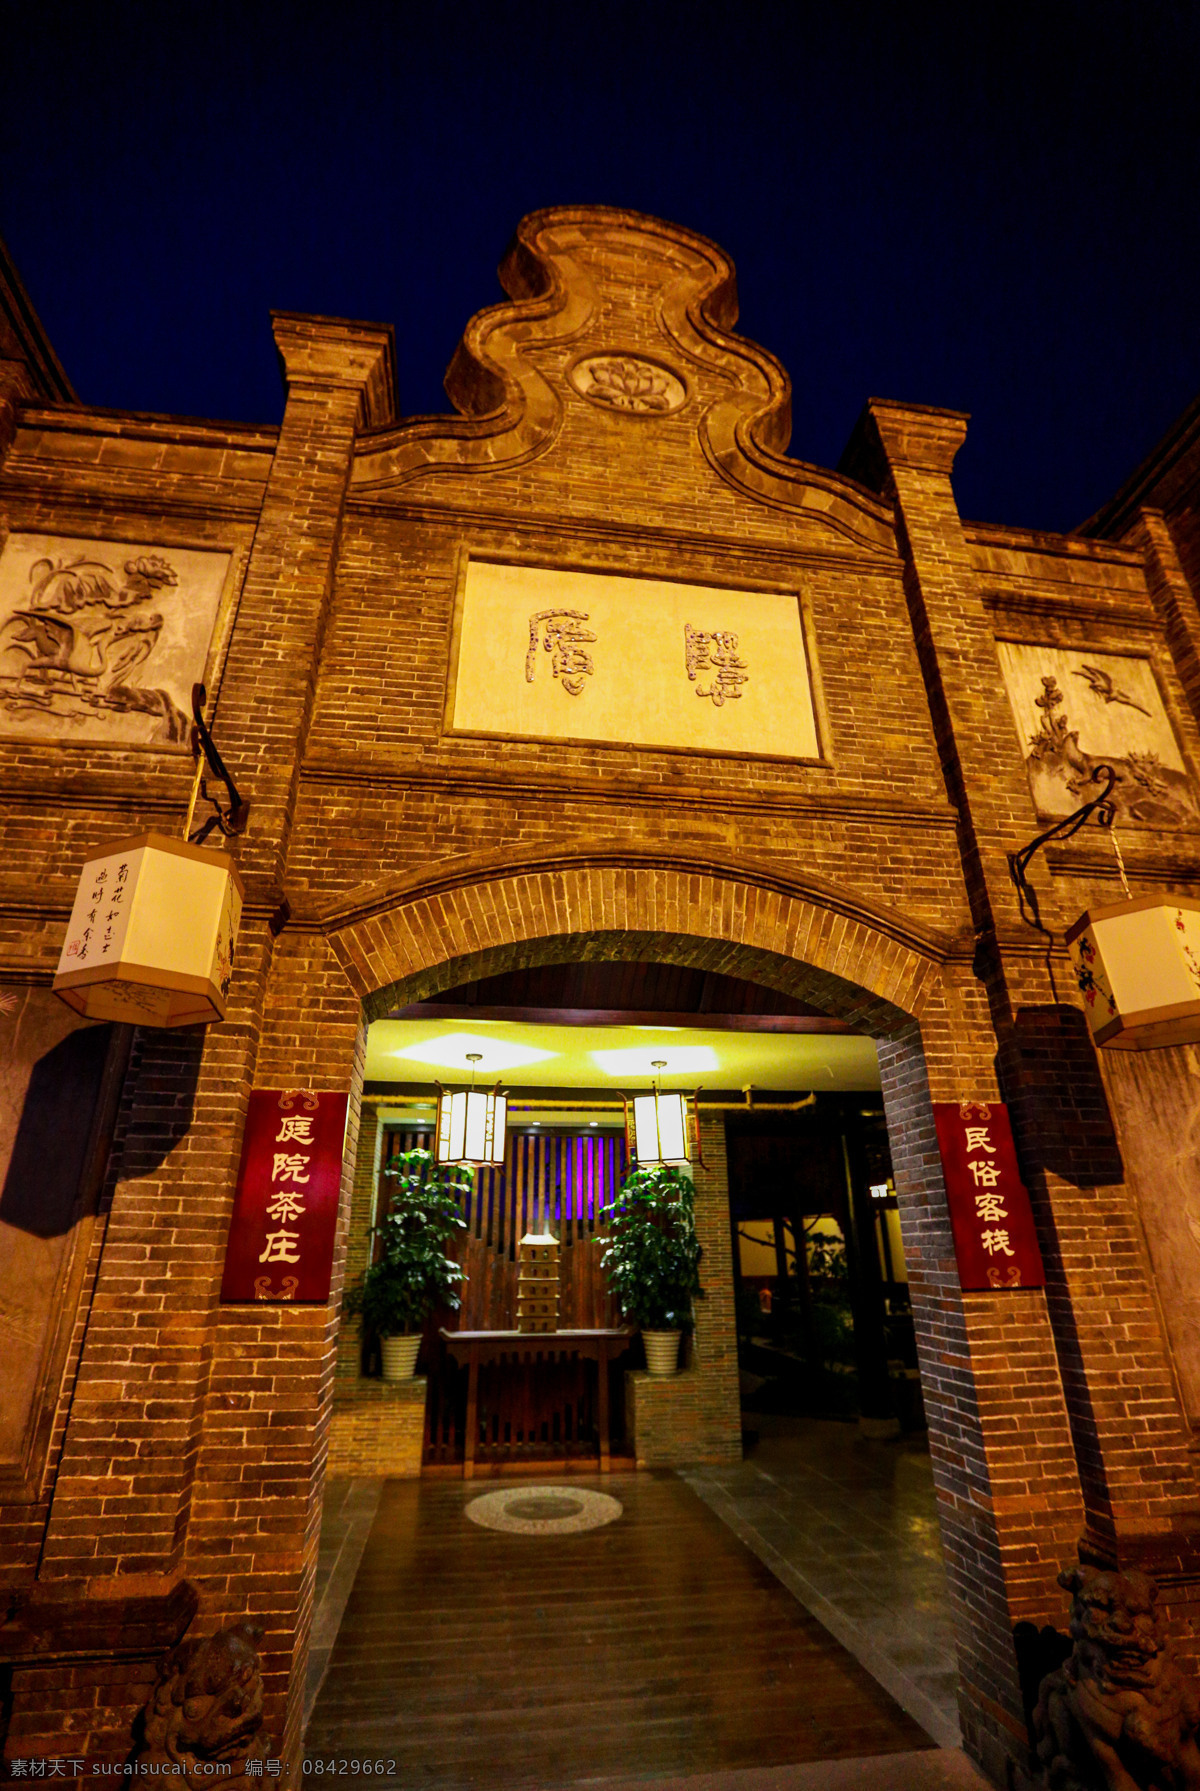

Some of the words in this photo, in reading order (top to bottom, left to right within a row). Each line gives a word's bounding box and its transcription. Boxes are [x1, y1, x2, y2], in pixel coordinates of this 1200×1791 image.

[259, 1114, 315, 1264] 庭院茶庄
[964, 1126, 1016, 1257] 民俗客栈
